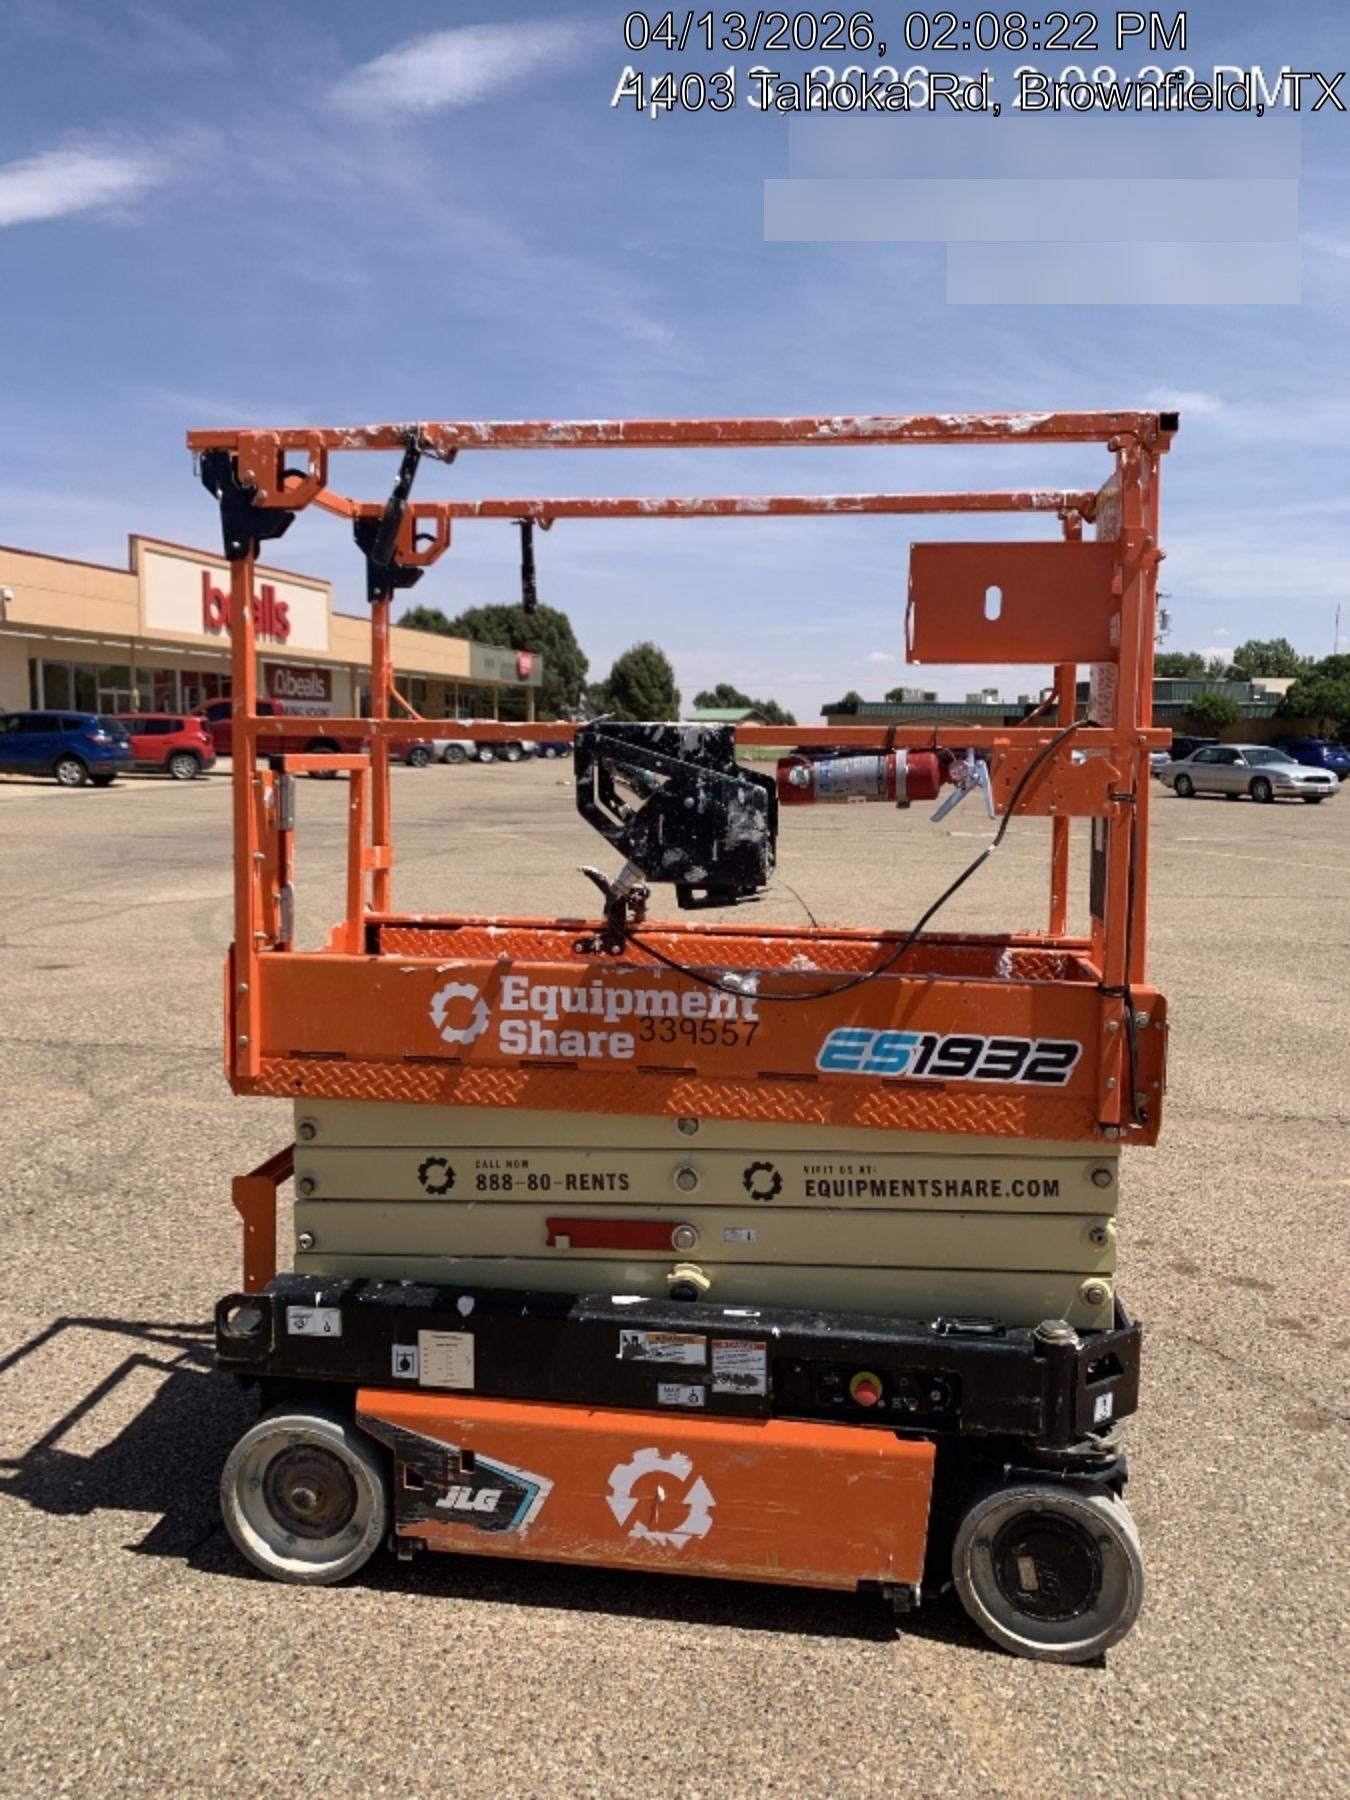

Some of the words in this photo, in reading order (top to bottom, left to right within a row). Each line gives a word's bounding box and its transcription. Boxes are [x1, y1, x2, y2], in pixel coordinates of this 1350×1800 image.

[202, 570, 291, 643] blls
[500, 975, 760, 1022] Equipment
[499, 1019, 635, 1059] Share
[638, 1015, 760, 1048] 339557
[816, 1027, 1083, 1086] ES1932
[475, 1172, 631, 1192] 888-80-RENTS
[804, 1178, 1060, 1199] EQUIPMENTSHARE.COM
[435, 1485, 503, 1513] JLG
